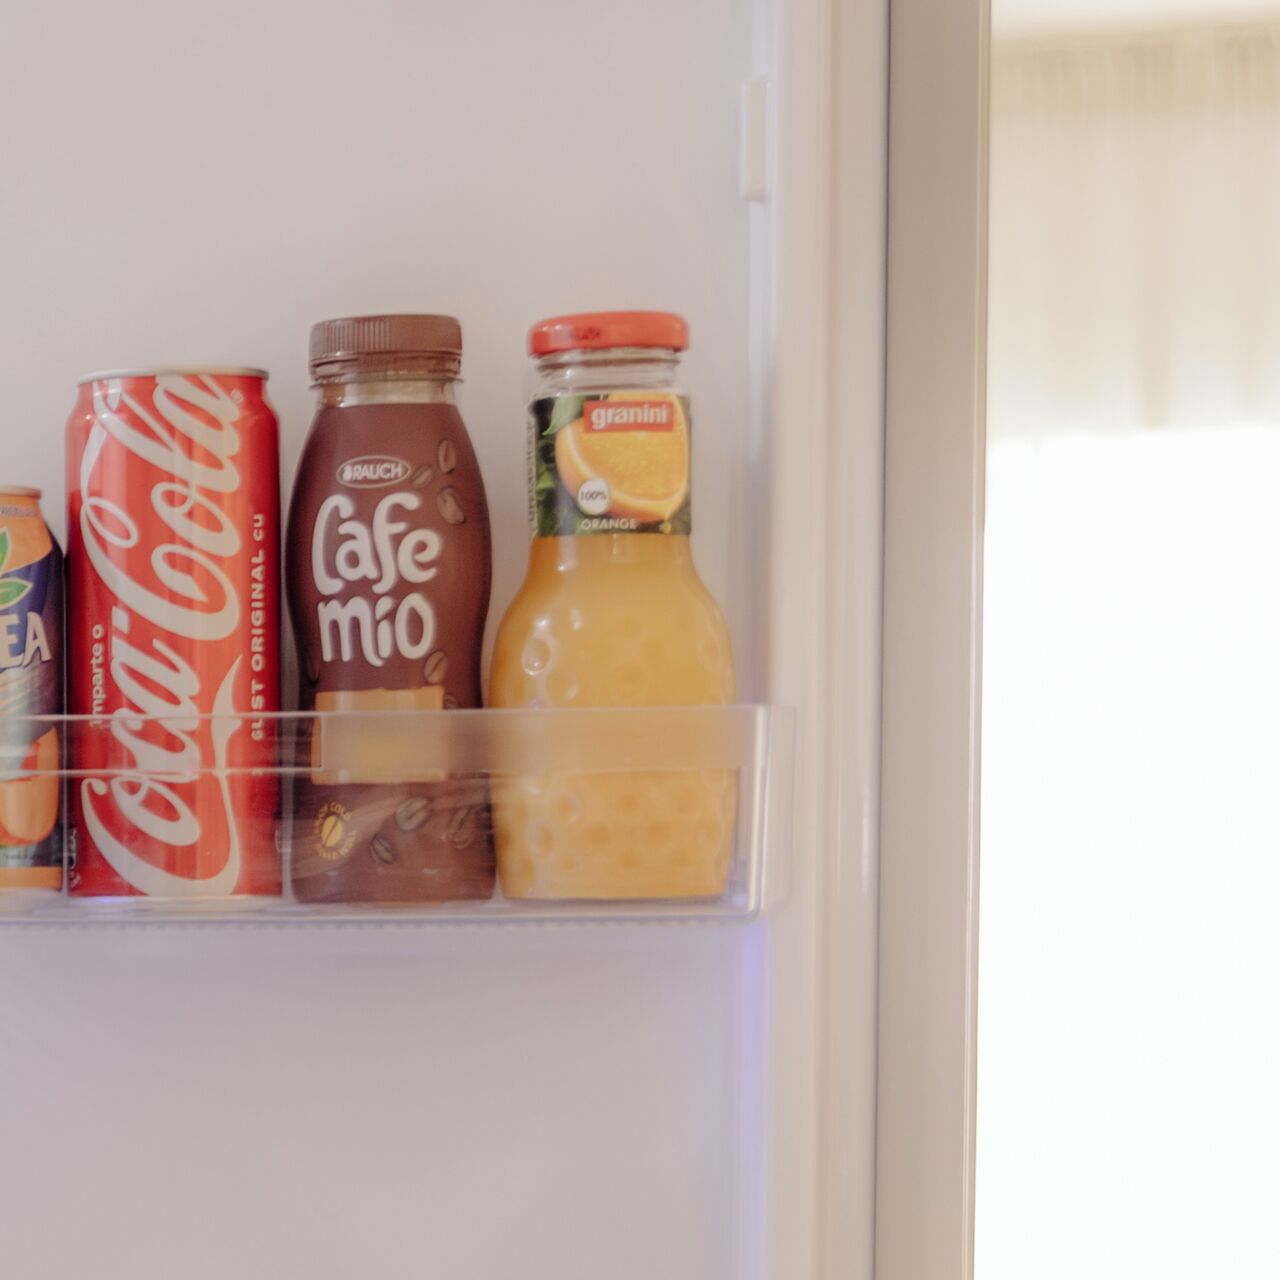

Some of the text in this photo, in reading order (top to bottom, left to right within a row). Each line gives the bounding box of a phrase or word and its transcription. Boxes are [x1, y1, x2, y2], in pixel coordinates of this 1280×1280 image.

[591, 404, 668, 430] granini
[351, 463, 404, 481] RAUCH
[580, 490, 608, 502] 100%
[581, 518, 637, 530] ORANGE
[311, 491, 441, 596] Cafe
[251, 549, 264, 672] ORIGINAL
[80, 374, 242, 896] Coca-Cola
